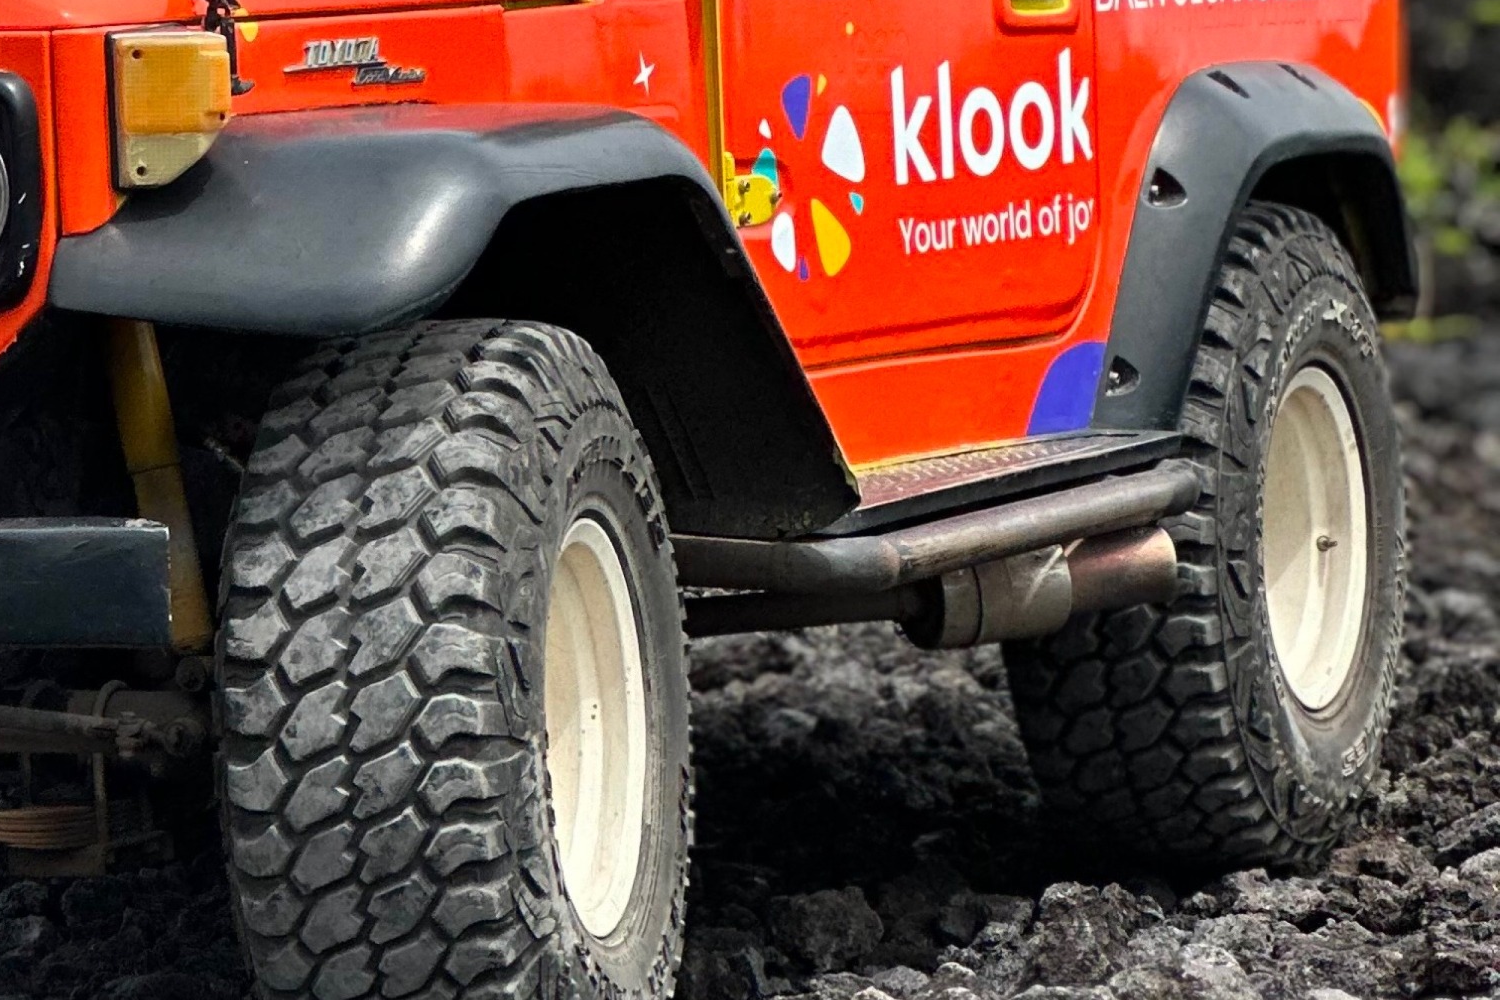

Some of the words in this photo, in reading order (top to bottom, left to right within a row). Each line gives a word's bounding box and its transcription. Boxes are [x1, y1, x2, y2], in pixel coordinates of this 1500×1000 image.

[305, 36, 380, 68] TOYOTA
[891, 47, 1093, 186] klook
[898, 217, 956, 255] Your
[961, 198, 1033, 247] world
[1038, 194, 1062, 238] of
